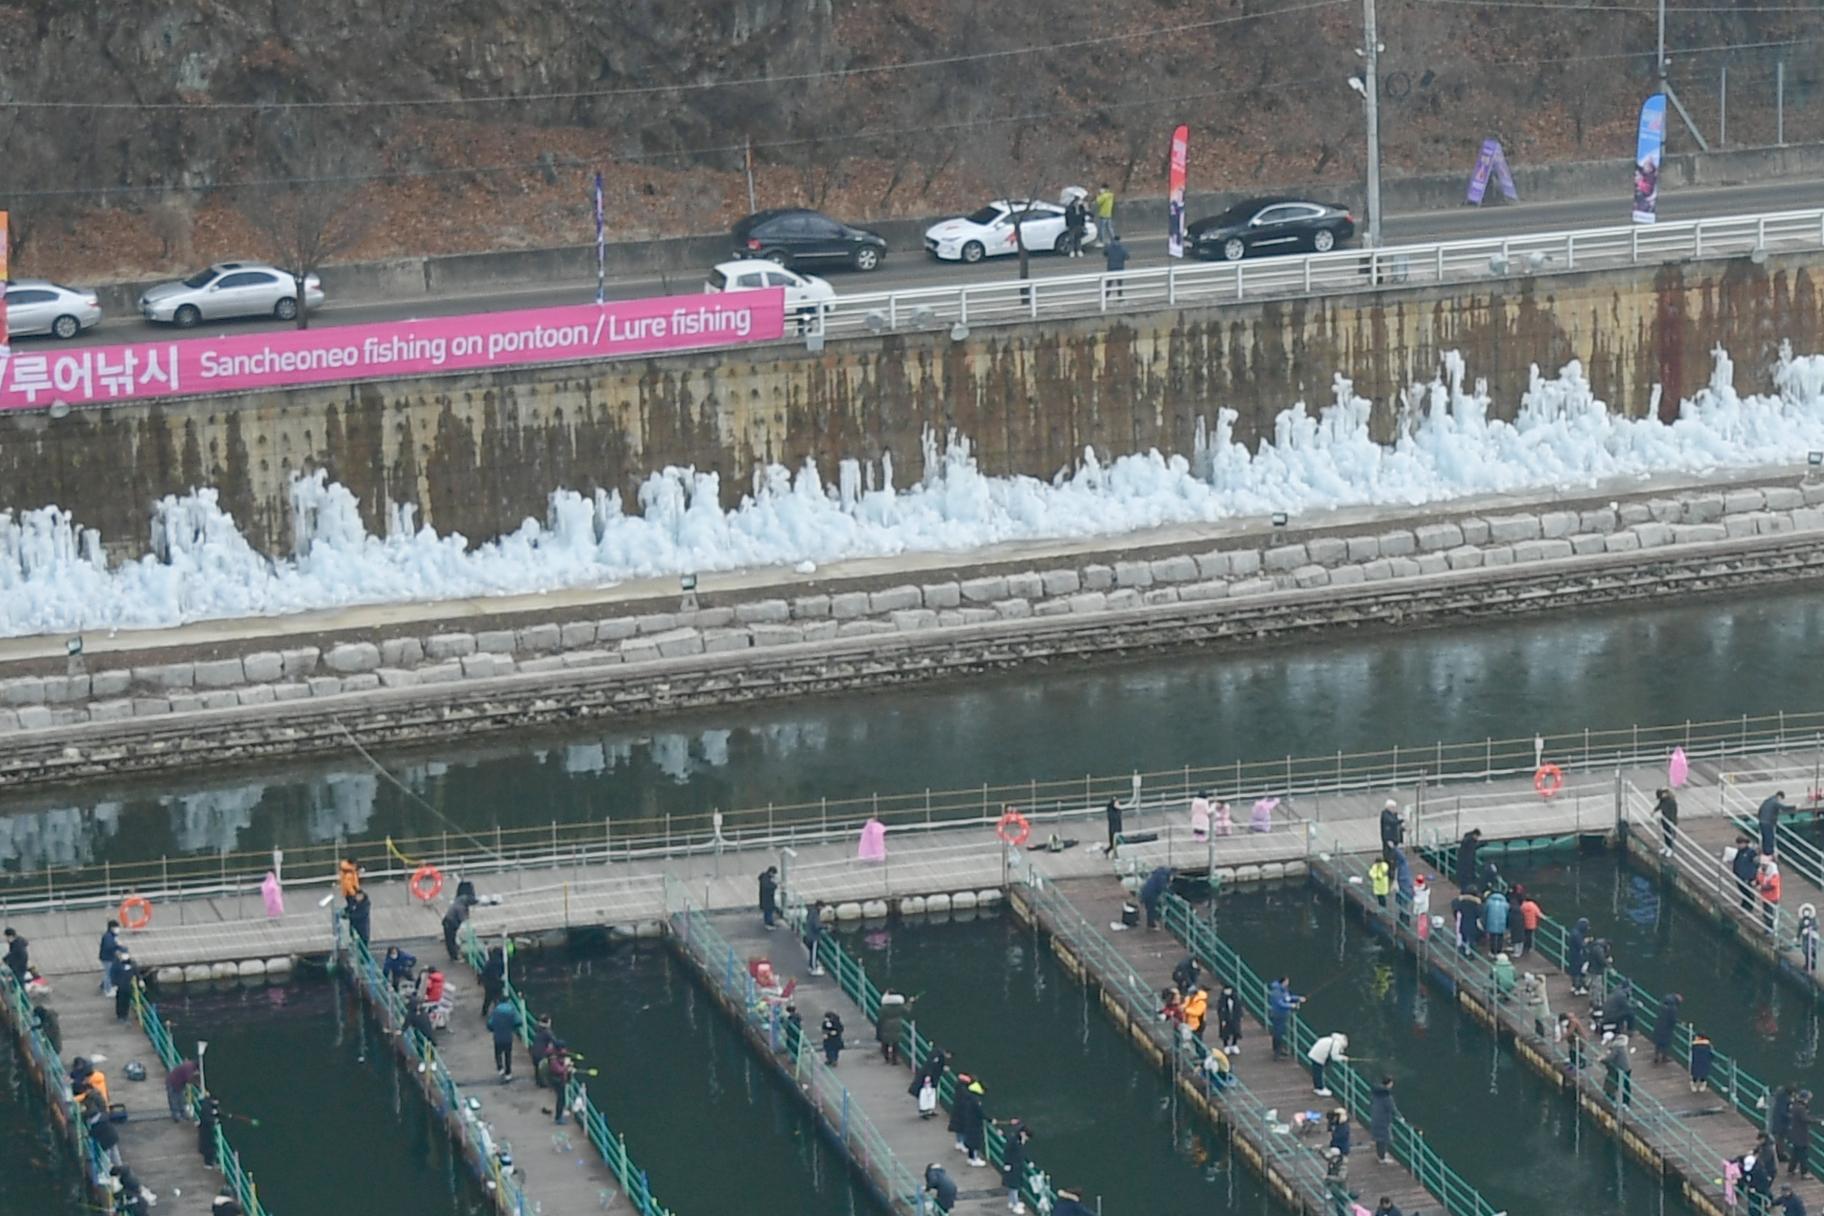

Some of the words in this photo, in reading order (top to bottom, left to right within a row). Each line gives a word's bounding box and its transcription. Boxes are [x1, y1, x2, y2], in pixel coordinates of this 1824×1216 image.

[200, 346, 358, 378] Sancheoneo
[364, 334, 446, 365] fishing
[451, 336, 483, 357] on
[488, 324, 589, 359] pontoon
[609, 315, 666, 342] Lure
[671, 305, 751, 336] fishing
